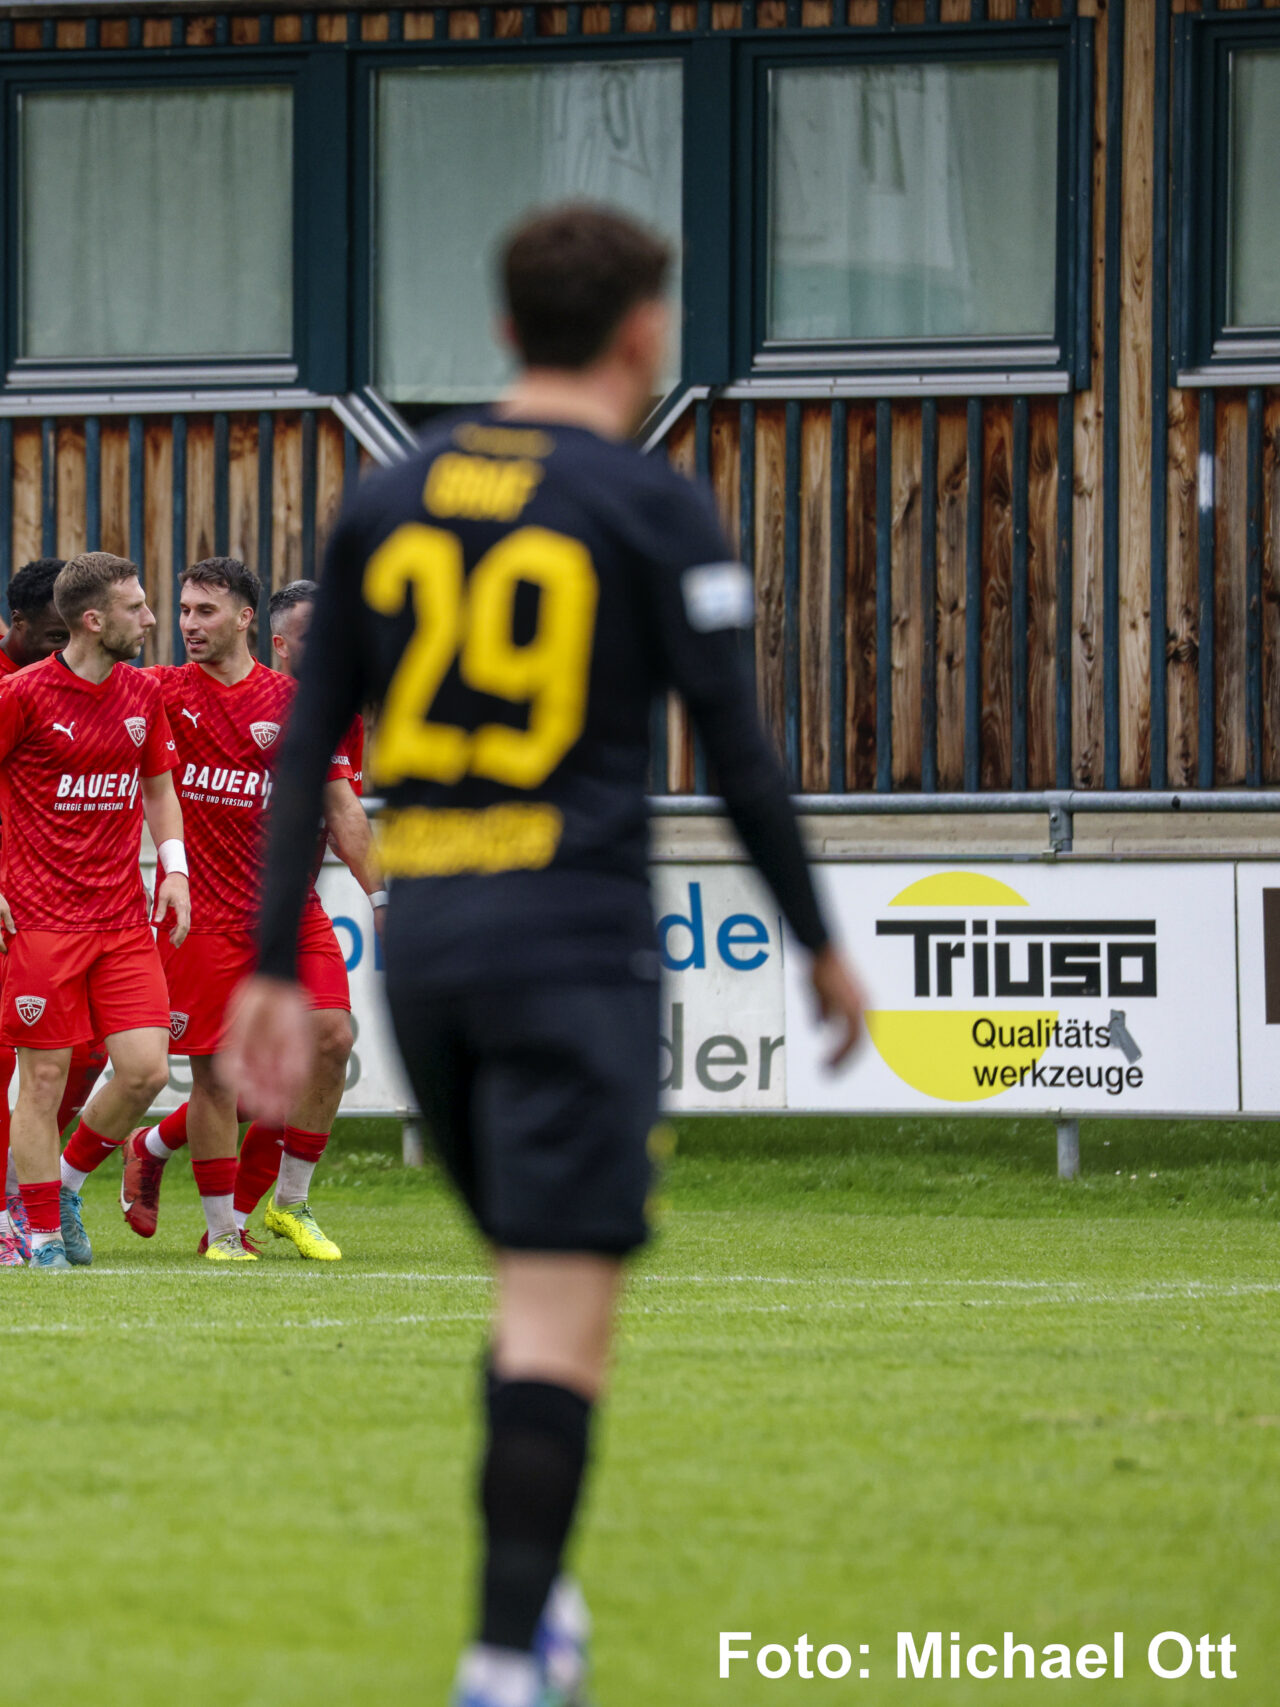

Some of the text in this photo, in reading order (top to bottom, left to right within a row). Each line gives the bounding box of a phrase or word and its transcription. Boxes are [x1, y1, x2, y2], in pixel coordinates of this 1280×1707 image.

[363, 523, 599, 789] 29
[56, 773, 131, 798] BAUER
[182, 763, 260, 796] BAUER
[54, 802, 81, 811] ENERGIE
[84, 803, 96, 811] UND
[221, 798, 253, 809] VERSTAND
[876, 919, 1157, 998] Triuso
[972, 1018, 1111, 1049] Qualitäts
[973, 1059, 1144, 1095] werkzeuge
